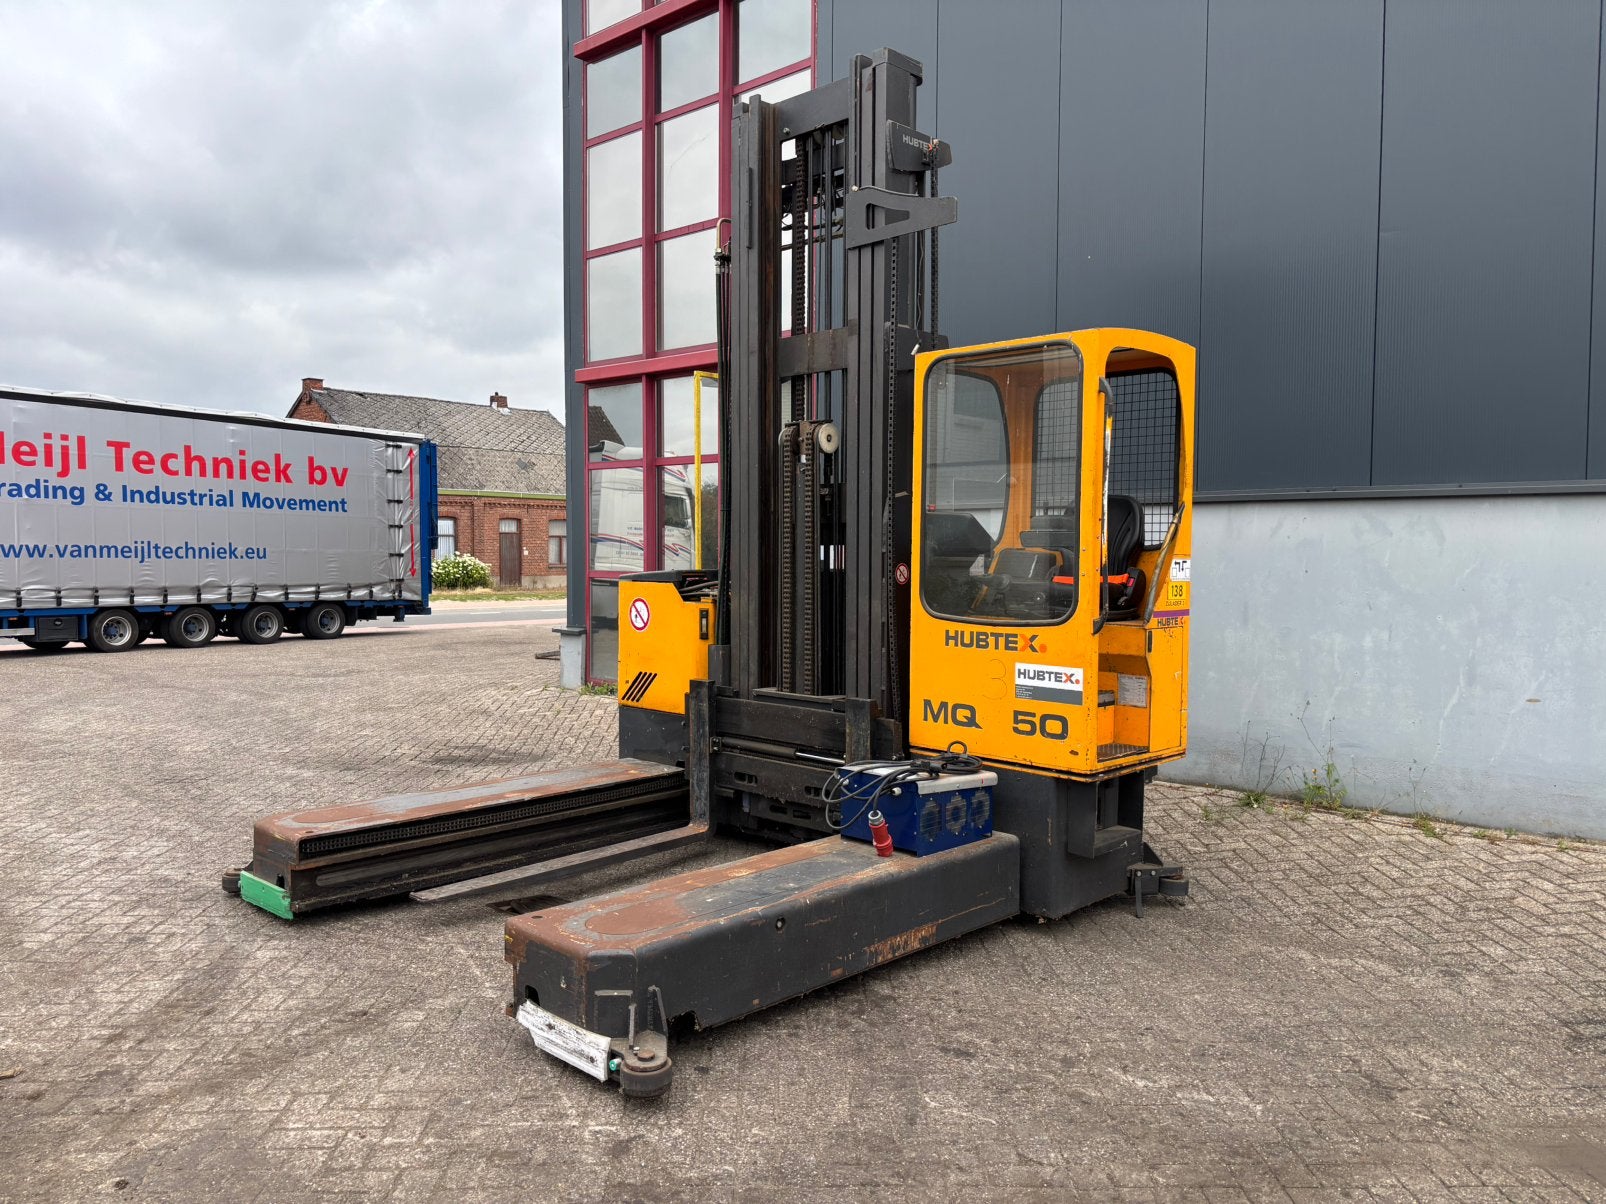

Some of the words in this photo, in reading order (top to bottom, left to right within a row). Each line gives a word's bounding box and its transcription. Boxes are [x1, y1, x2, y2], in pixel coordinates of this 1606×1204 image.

[107, 440, 293, 484] Techniek
[307, 455, 348, 487] bv
[94, 483, 113, 502] &
[122, 484, 234, 508] Industrial
[241, 491, 348, 513] Movement
[1171, 585, 1183, 597] 138
[923, 699, 983, 730] MQ
[1012, 710, 1069, 741] 50
